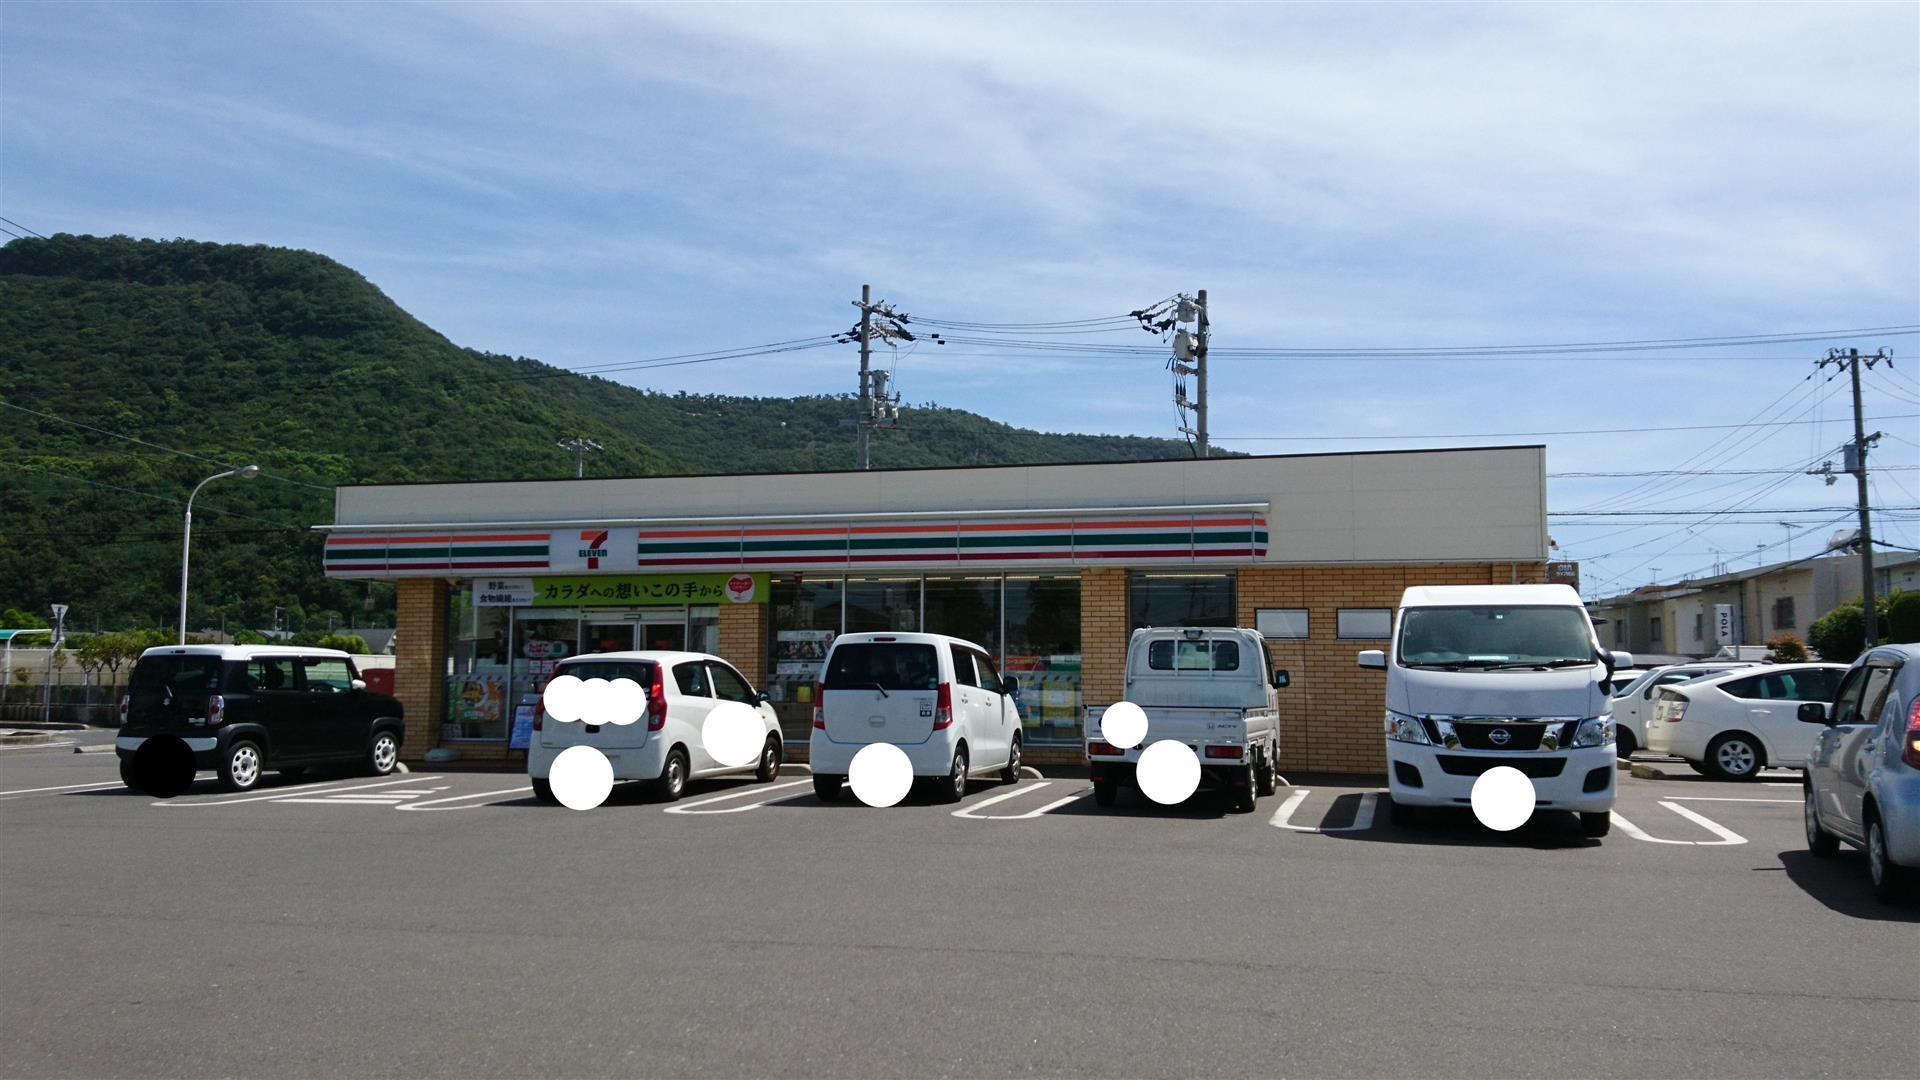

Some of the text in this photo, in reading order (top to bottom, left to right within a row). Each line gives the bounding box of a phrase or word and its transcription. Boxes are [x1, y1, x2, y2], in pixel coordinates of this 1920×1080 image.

[580, 531, 608, 570] 7
[545, 582, 723, 600] カラダへの想いこの手から
[1720, 612, 1729, 637] POLA
